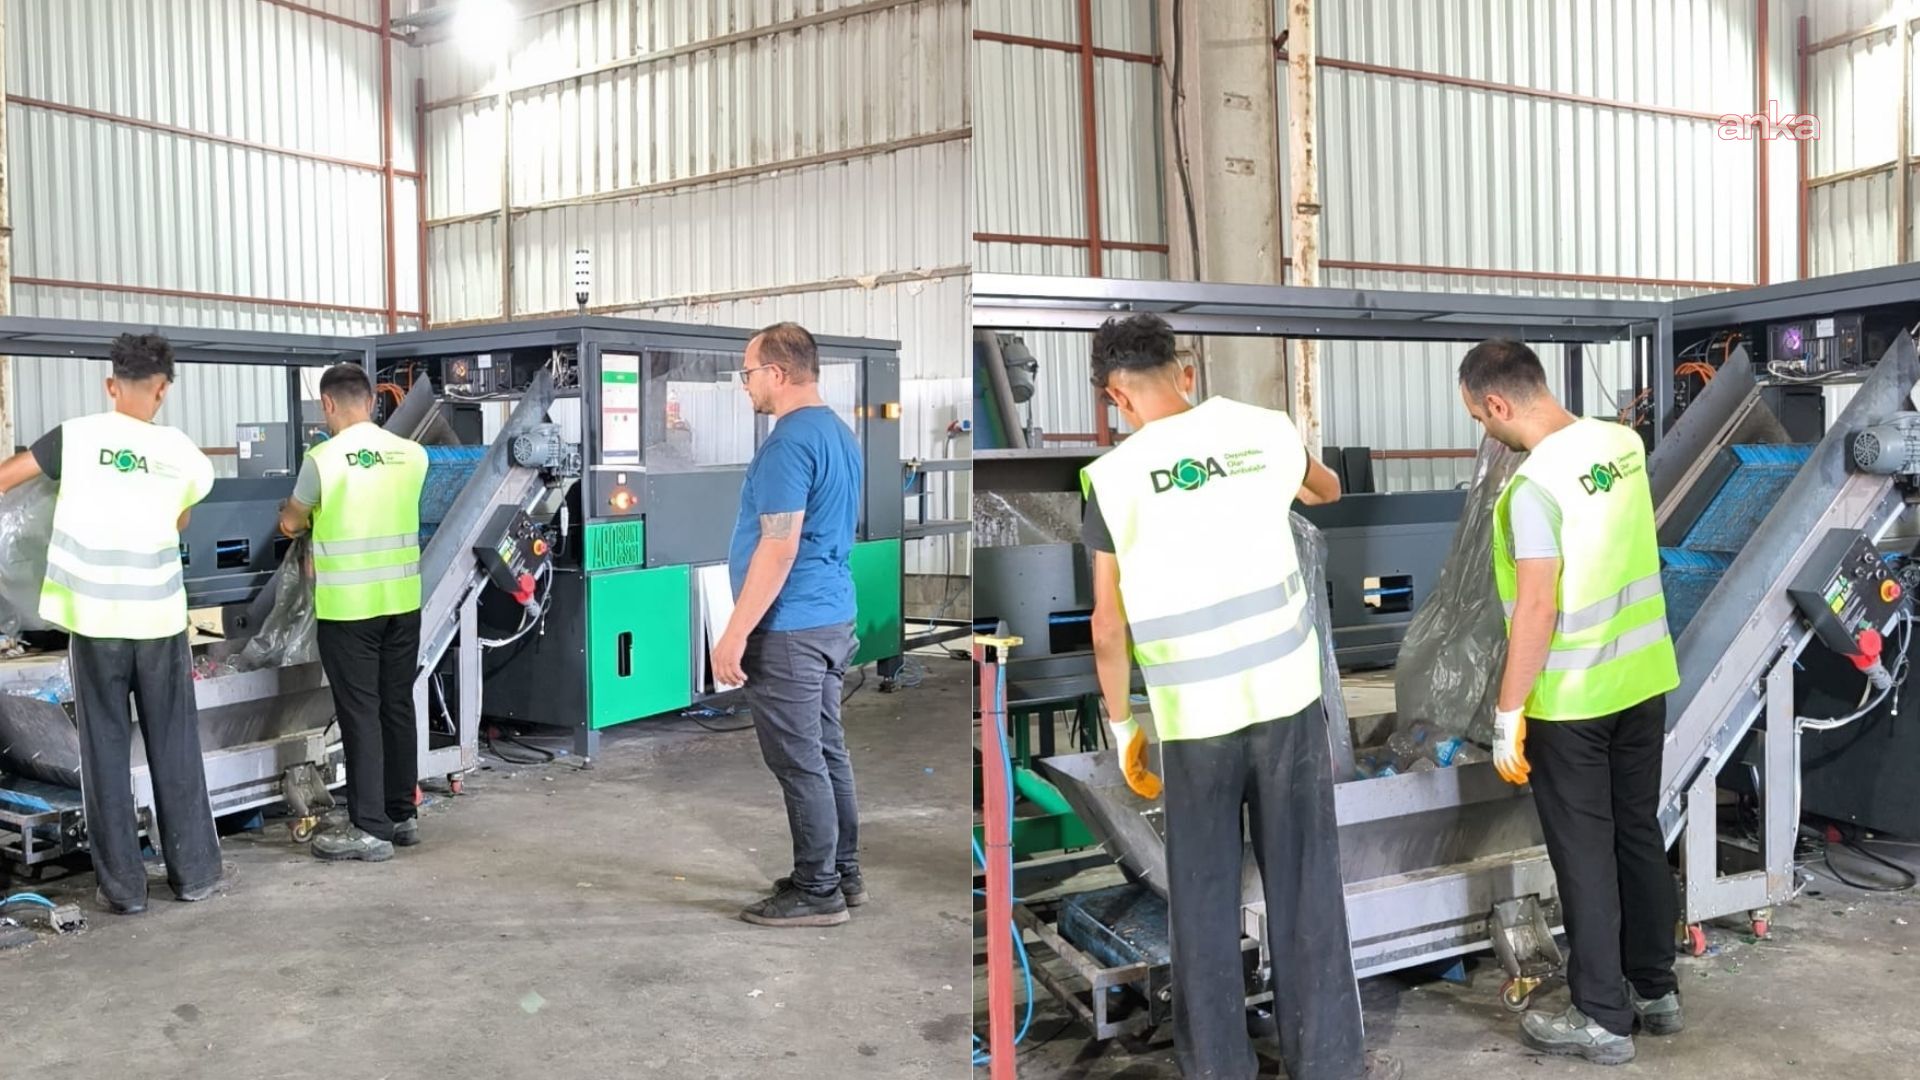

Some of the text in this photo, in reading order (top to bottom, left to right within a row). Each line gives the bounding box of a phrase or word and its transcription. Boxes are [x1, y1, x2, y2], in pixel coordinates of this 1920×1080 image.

[99, 448, 149, 474] DOA
[345, 449, 385, 468] DOA
[1150, 457, 1227, 493] DOA
[1578, 461, 1623, 496] DOA
